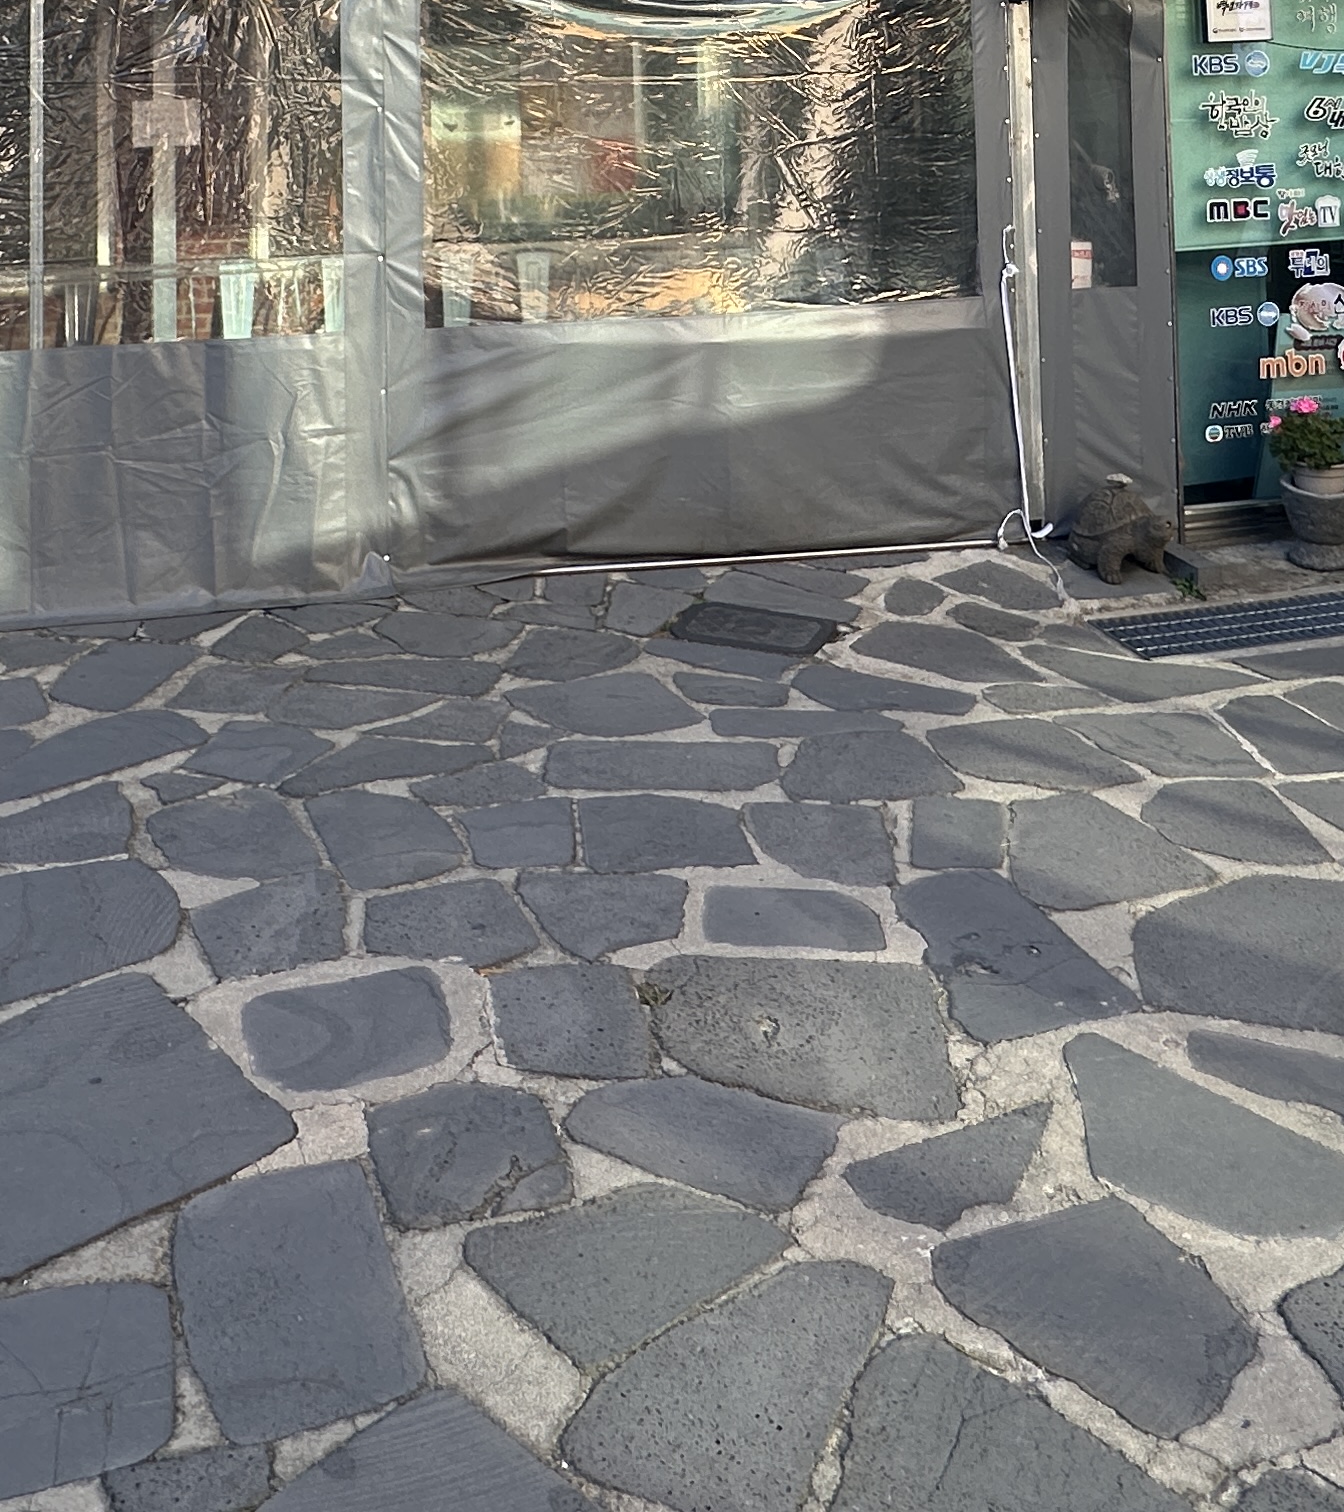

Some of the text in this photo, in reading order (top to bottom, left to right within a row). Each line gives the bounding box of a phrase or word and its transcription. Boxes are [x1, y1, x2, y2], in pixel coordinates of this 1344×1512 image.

[1296, 2, 1339, 35] 여행
[1193, 54, 1240, 76] KBS
[1207, 197, 1271, 222] MBC
[1319, 205, 1338, 224] TV
[1234, 256, 1269, 278] SBS
[1210, 306, 1254, 328] KBS
[1259, 348, 1326, 380] mbn
[1209, 399, 1258, 420] NHK
[1223, 424, 1254, 439] TVB
